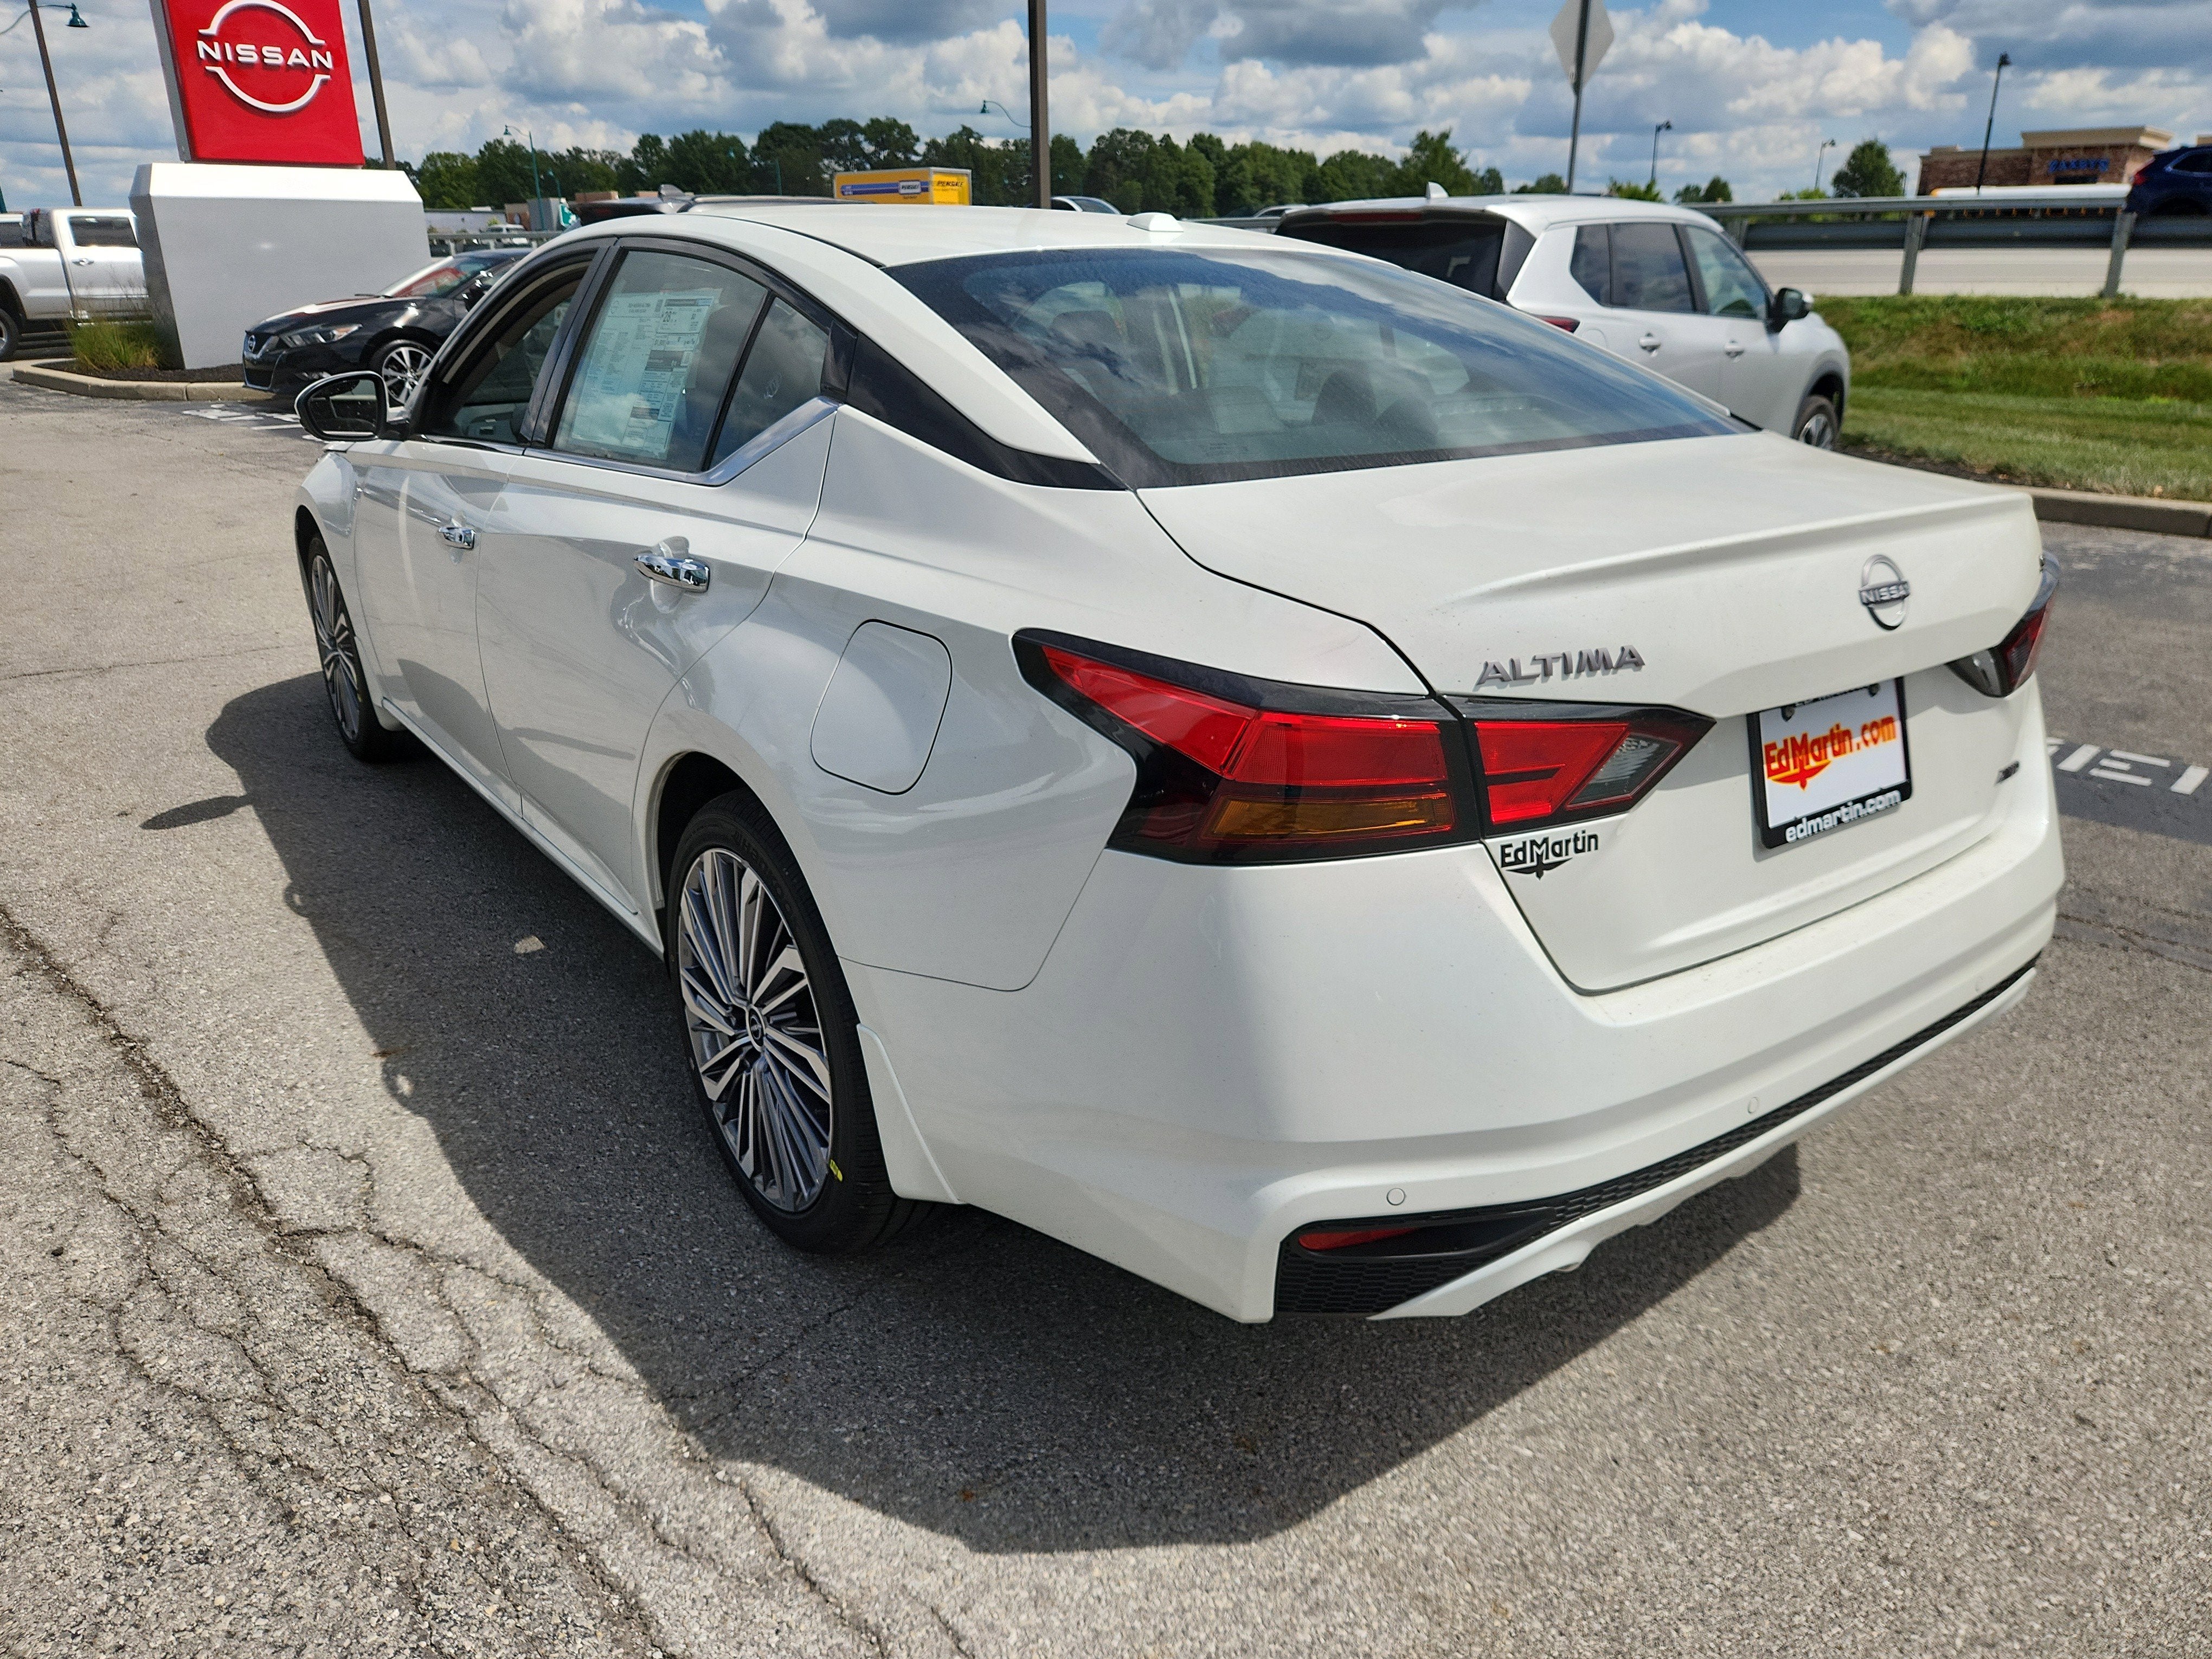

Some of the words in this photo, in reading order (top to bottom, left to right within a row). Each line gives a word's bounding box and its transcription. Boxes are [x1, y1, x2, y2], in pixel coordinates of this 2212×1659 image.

[197, 40, 333, 69] NISSAN
[1475, 645, 1645, 685] ALTIMA
[1785, 790, 1901, 843] edmartin.com
